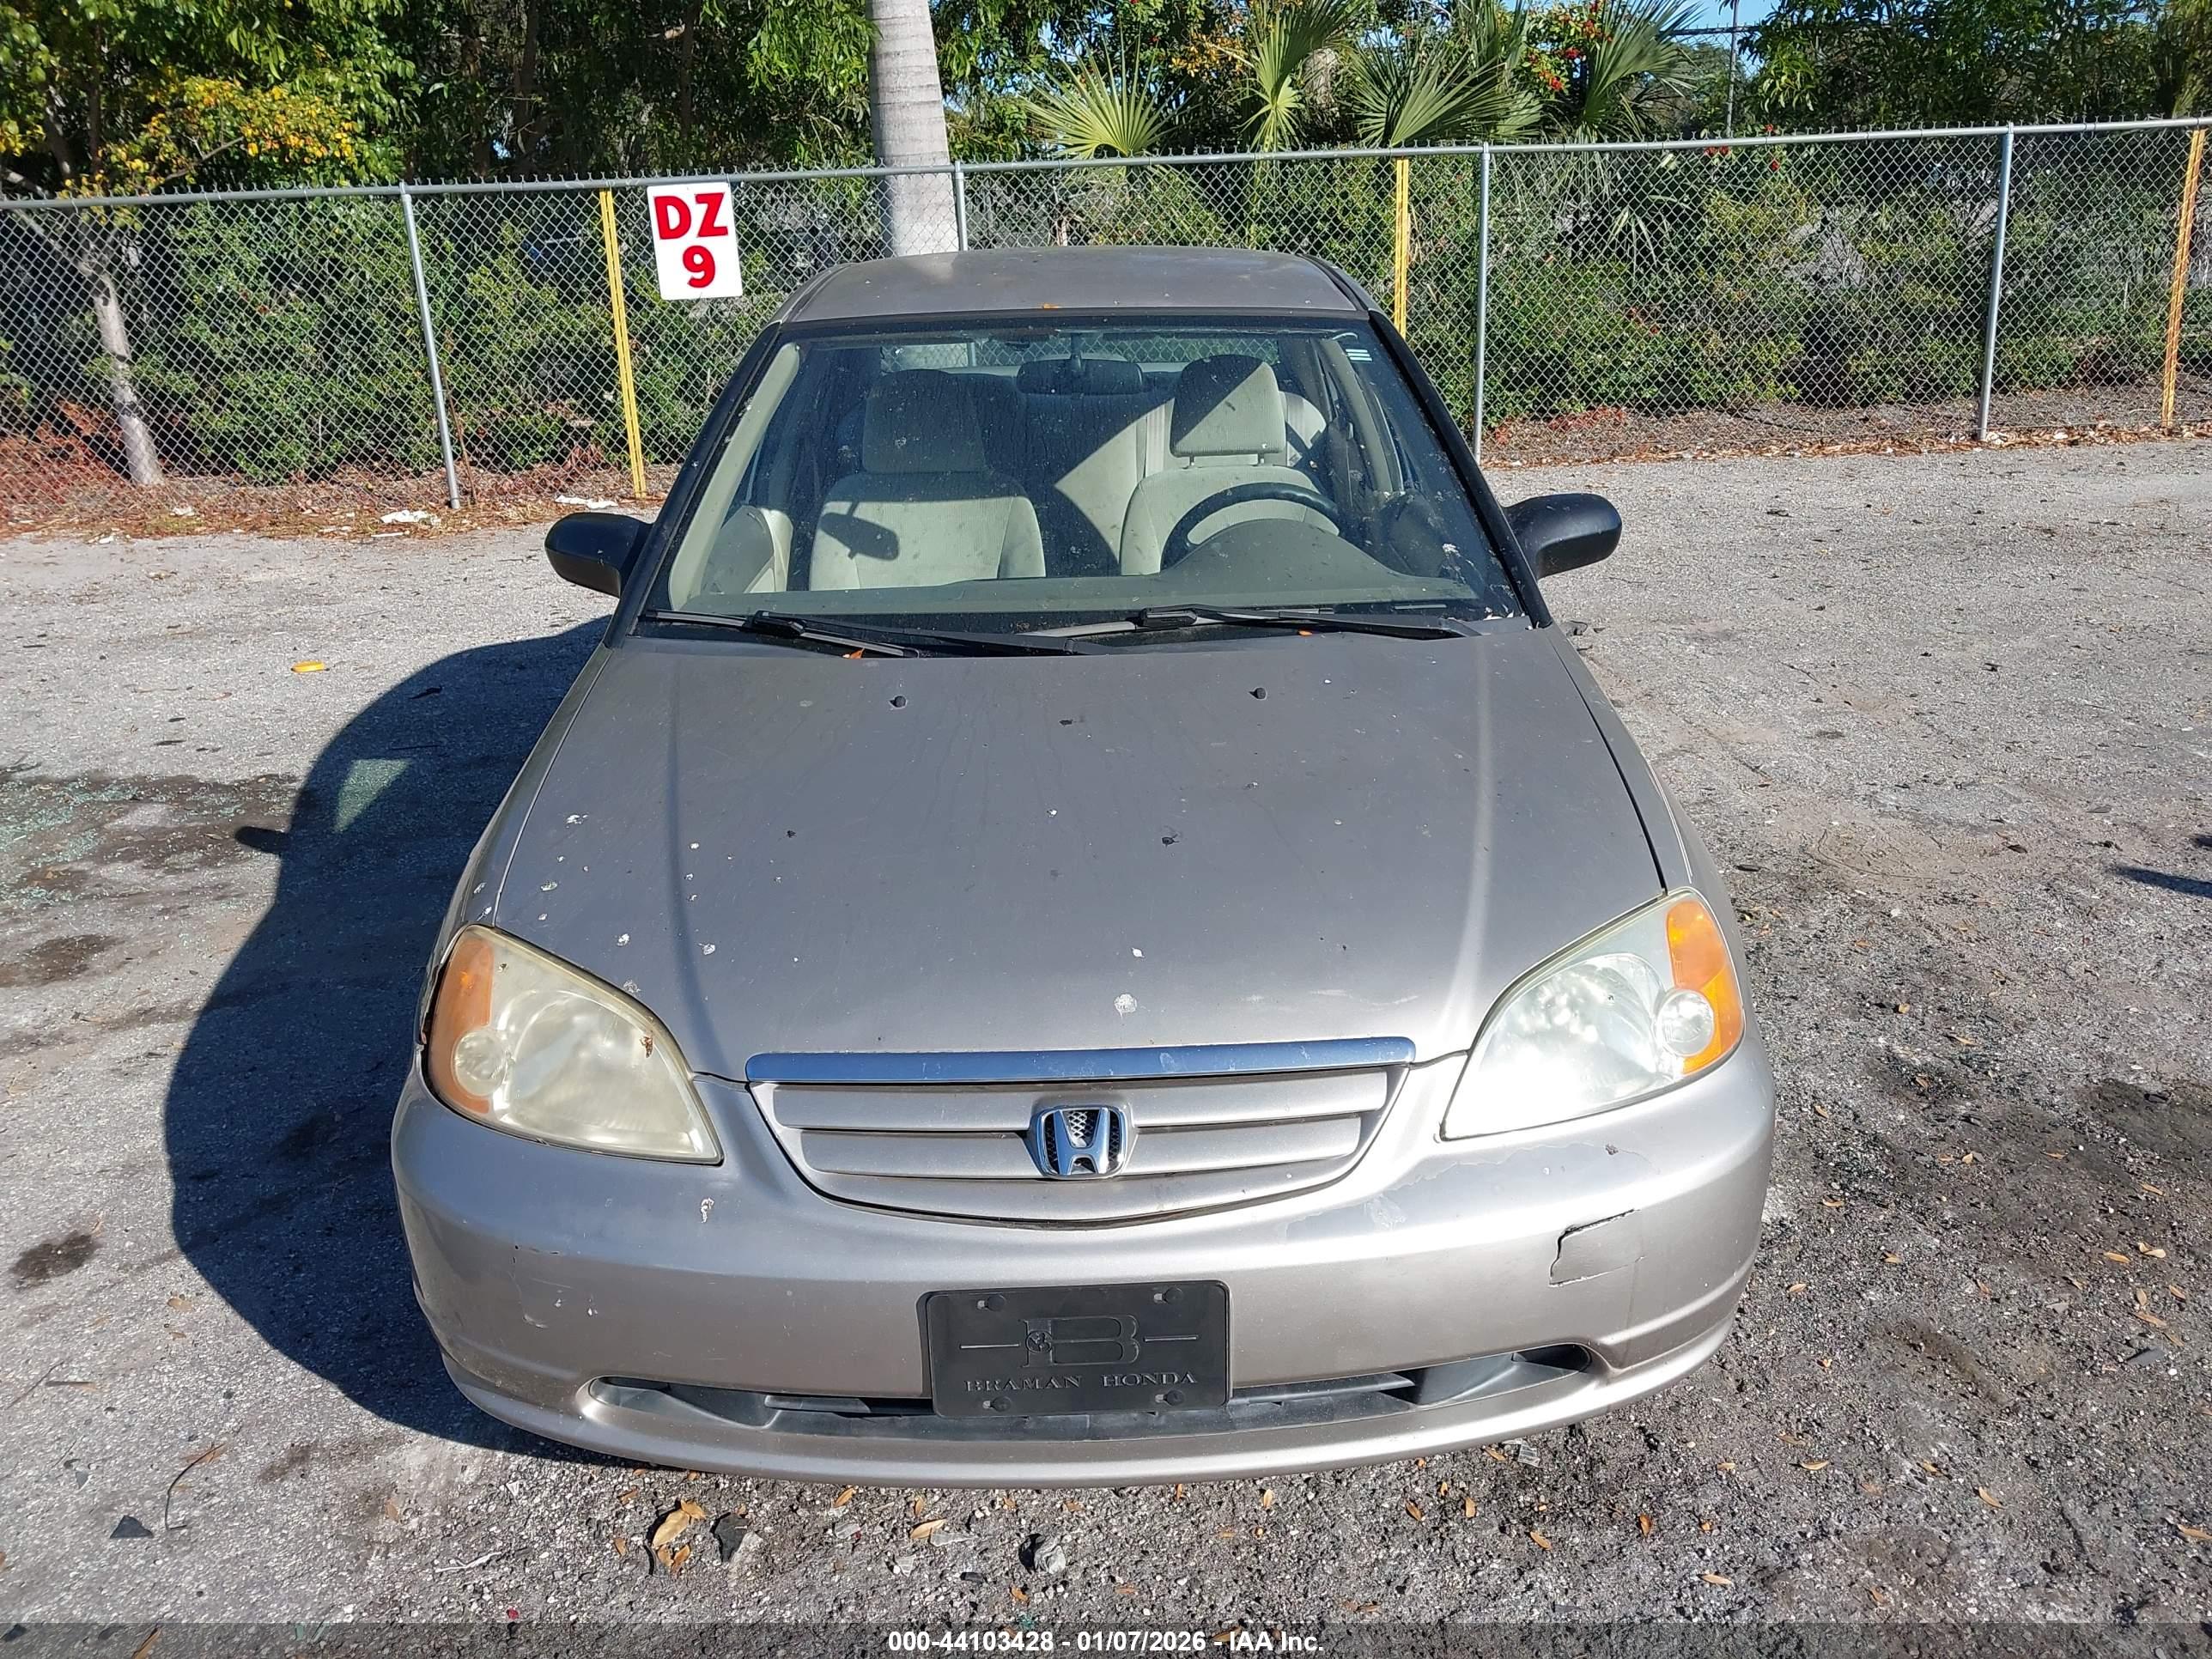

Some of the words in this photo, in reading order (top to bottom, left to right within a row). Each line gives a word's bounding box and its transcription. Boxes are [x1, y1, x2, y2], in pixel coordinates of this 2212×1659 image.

[653, 191, 729, 240] DZ
[682, 245, 716, 289] 9
[964, 1374, 1082, 1393] BRAMAN
[1102, 1371, 1198, 1388] HONDA
